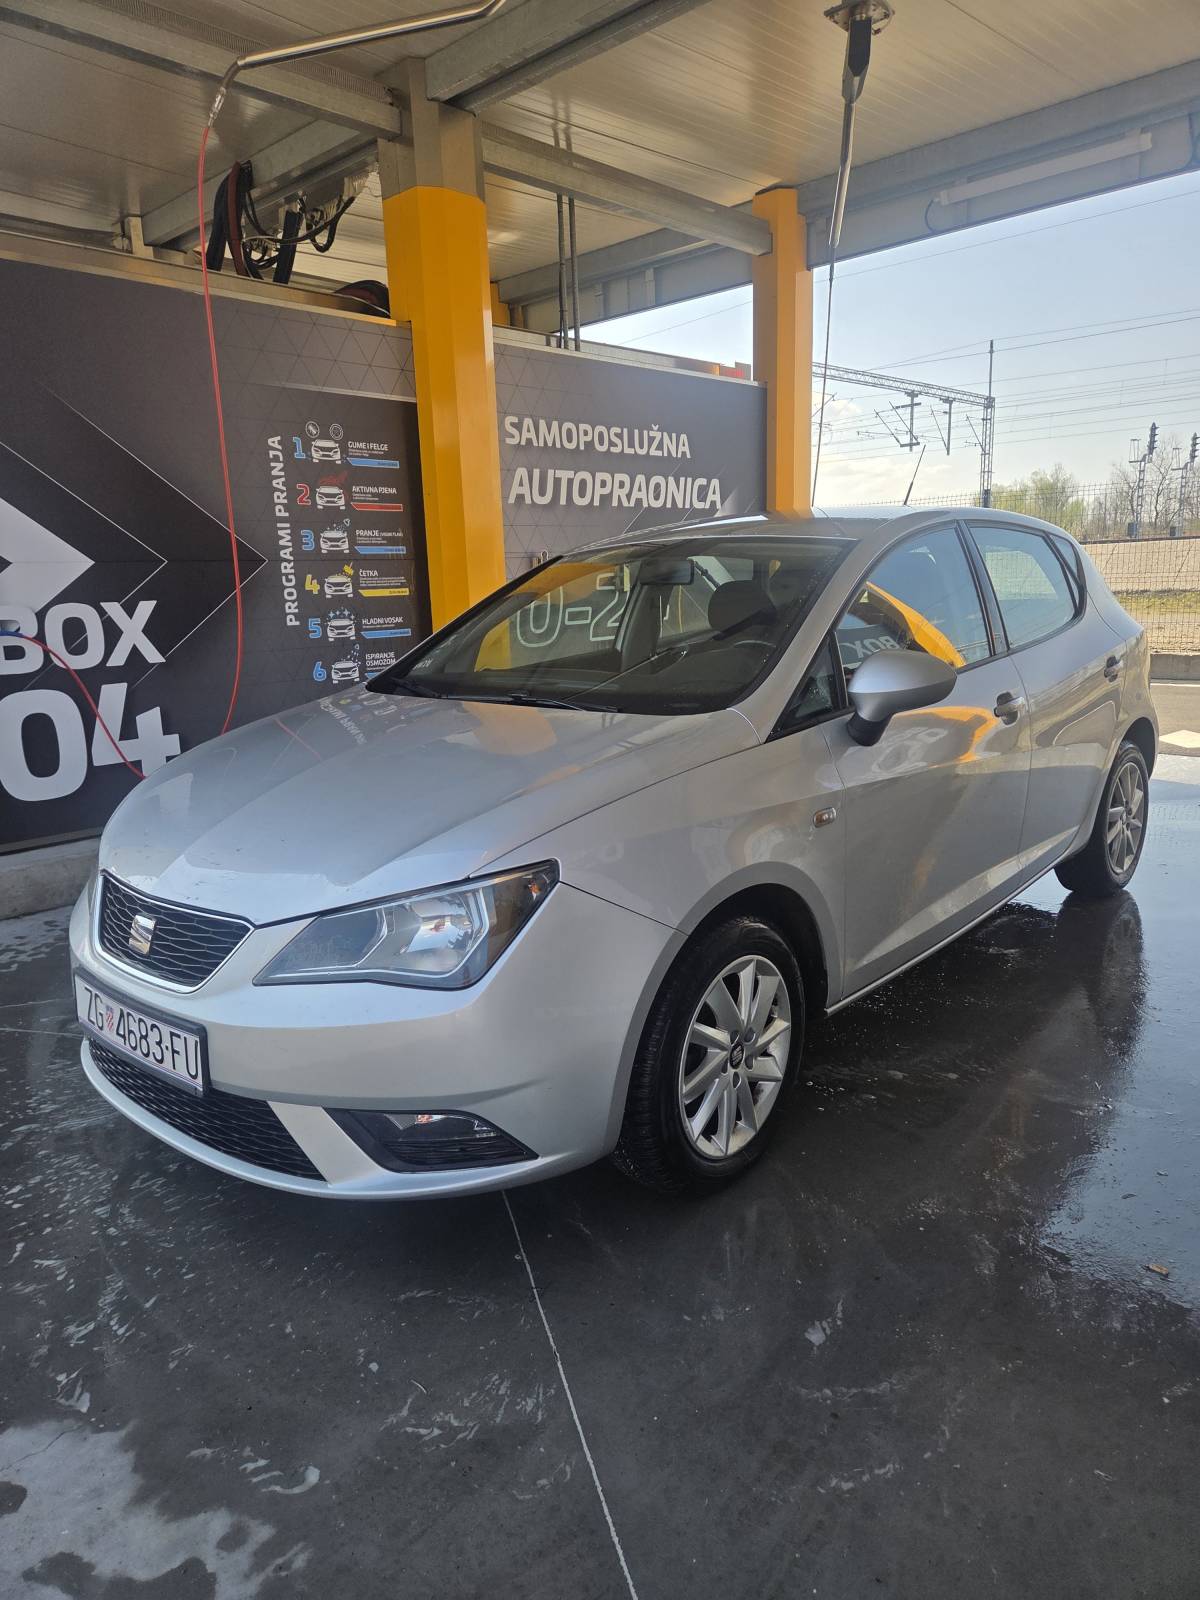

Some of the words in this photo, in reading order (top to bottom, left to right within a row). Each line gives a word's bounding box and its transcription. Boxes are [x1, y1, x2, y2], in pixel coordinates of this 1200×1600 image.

[292, 436, 306, 459] 1
[347, 441, 367, 449] GUME
[370, 443, 389, 451] FELGE
[504, 415, 691, 459] SAMOPOSLUŽNA
[267, 435, 289, 517] PRANJA
[296, 483, 312, 506] 2
[352, 485, 378, 493] AKTIVNA
[508, 467, 722, 509] AUTOPRAONICA
[300, 529, 315, 551] 3
[355, 529, 379, 537] PRANJE
[277, 523, 300, 626] PROGRAMI
[304, 574, 321, 595] 4
[307, 617, 323, 639] 5
[362, 617, 384, 625] HLADNI
[384, 616, 404, 624] VOSAK
[0, 600, 166, 675] BOX
[365, 651, 395, 660] ISPIRANJE
[312, 661, 327, 682] 6
[0, 682, 181, 801] 04
[84, 986, 104, 1031] ZG
